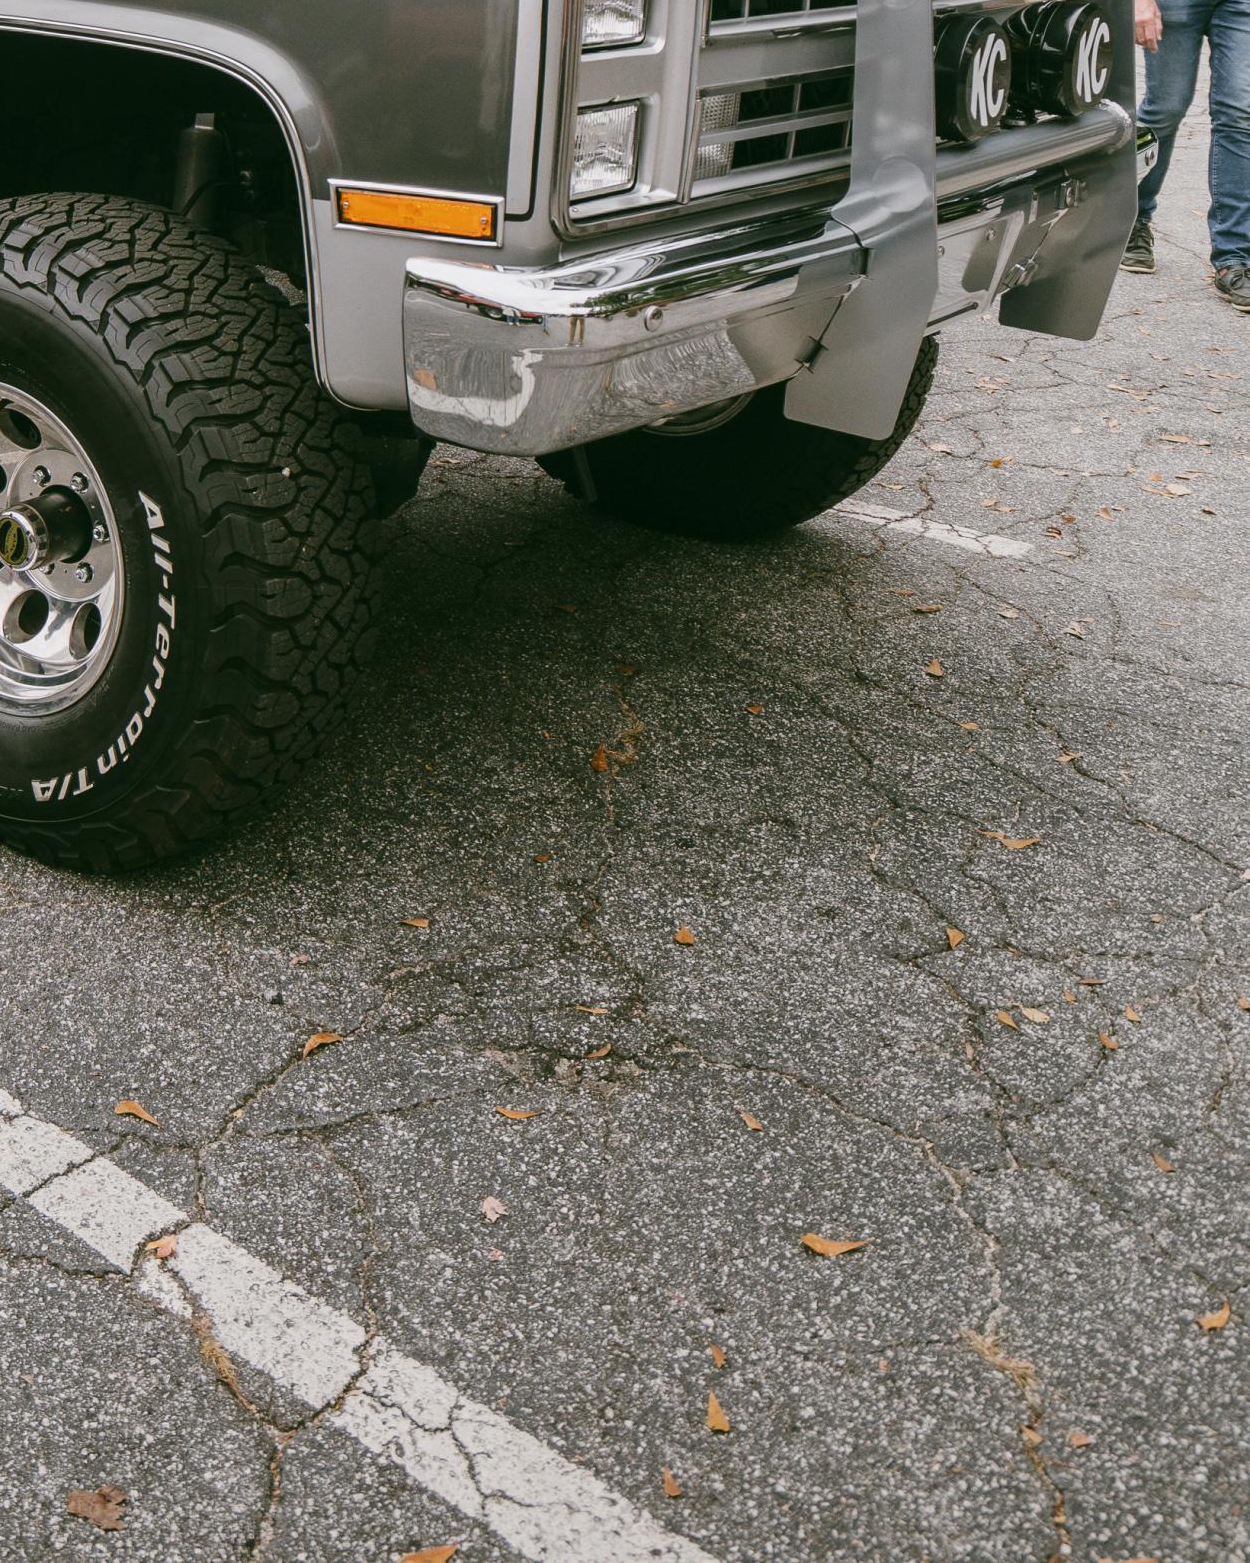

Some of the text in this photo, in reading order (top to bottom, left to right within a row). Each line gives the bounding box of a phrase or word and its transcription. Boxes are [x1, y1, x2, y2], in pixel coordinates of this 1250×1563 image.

[970, 32, 1007, 127] KC
[1076, 16, 1111, 103] KC
[30, 489, 178, 802] All-Terrain T/A
